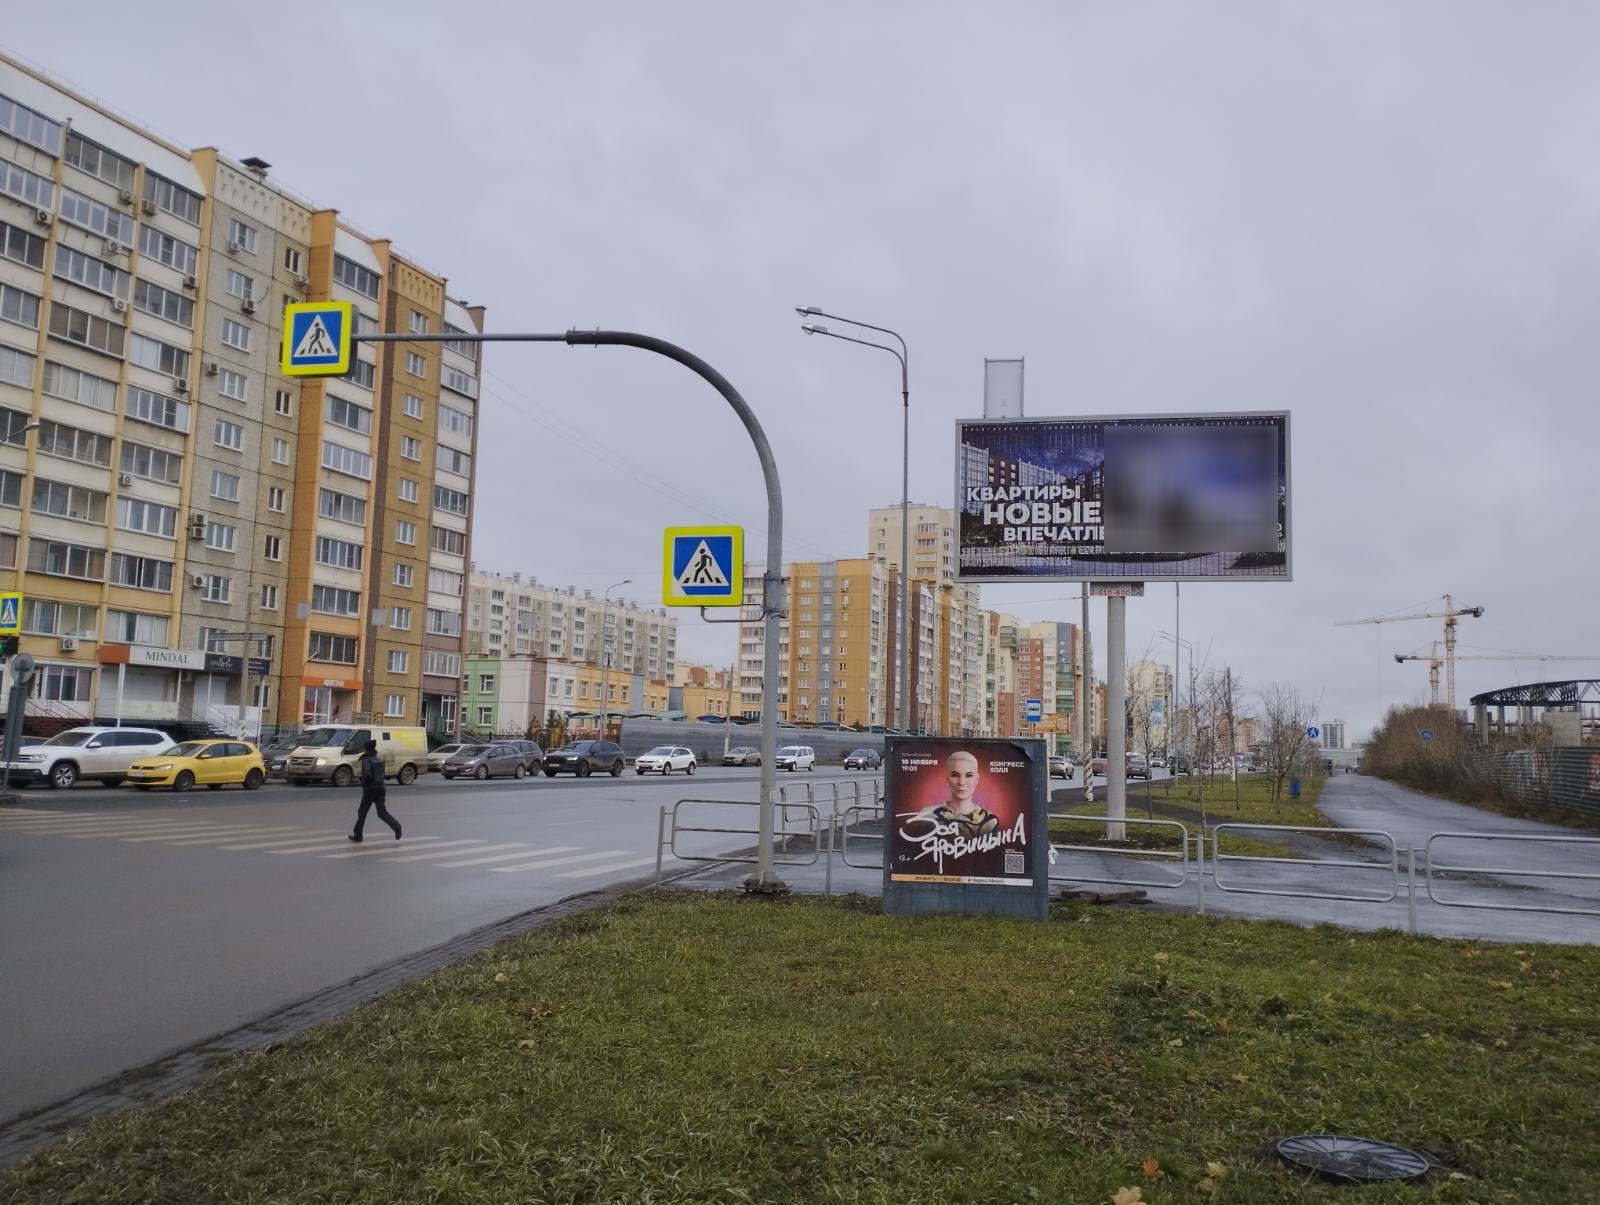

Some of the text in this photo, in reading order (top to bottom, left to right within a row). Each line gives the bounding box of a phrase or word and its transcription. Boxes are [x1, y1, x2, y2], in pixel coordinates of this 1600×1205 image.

[966, 485, 1081, 501] КВАРТИРЫ
[983, 501, 1101, 525] НОВЫЕ
[145, 650, 189, 664] MINDAL
